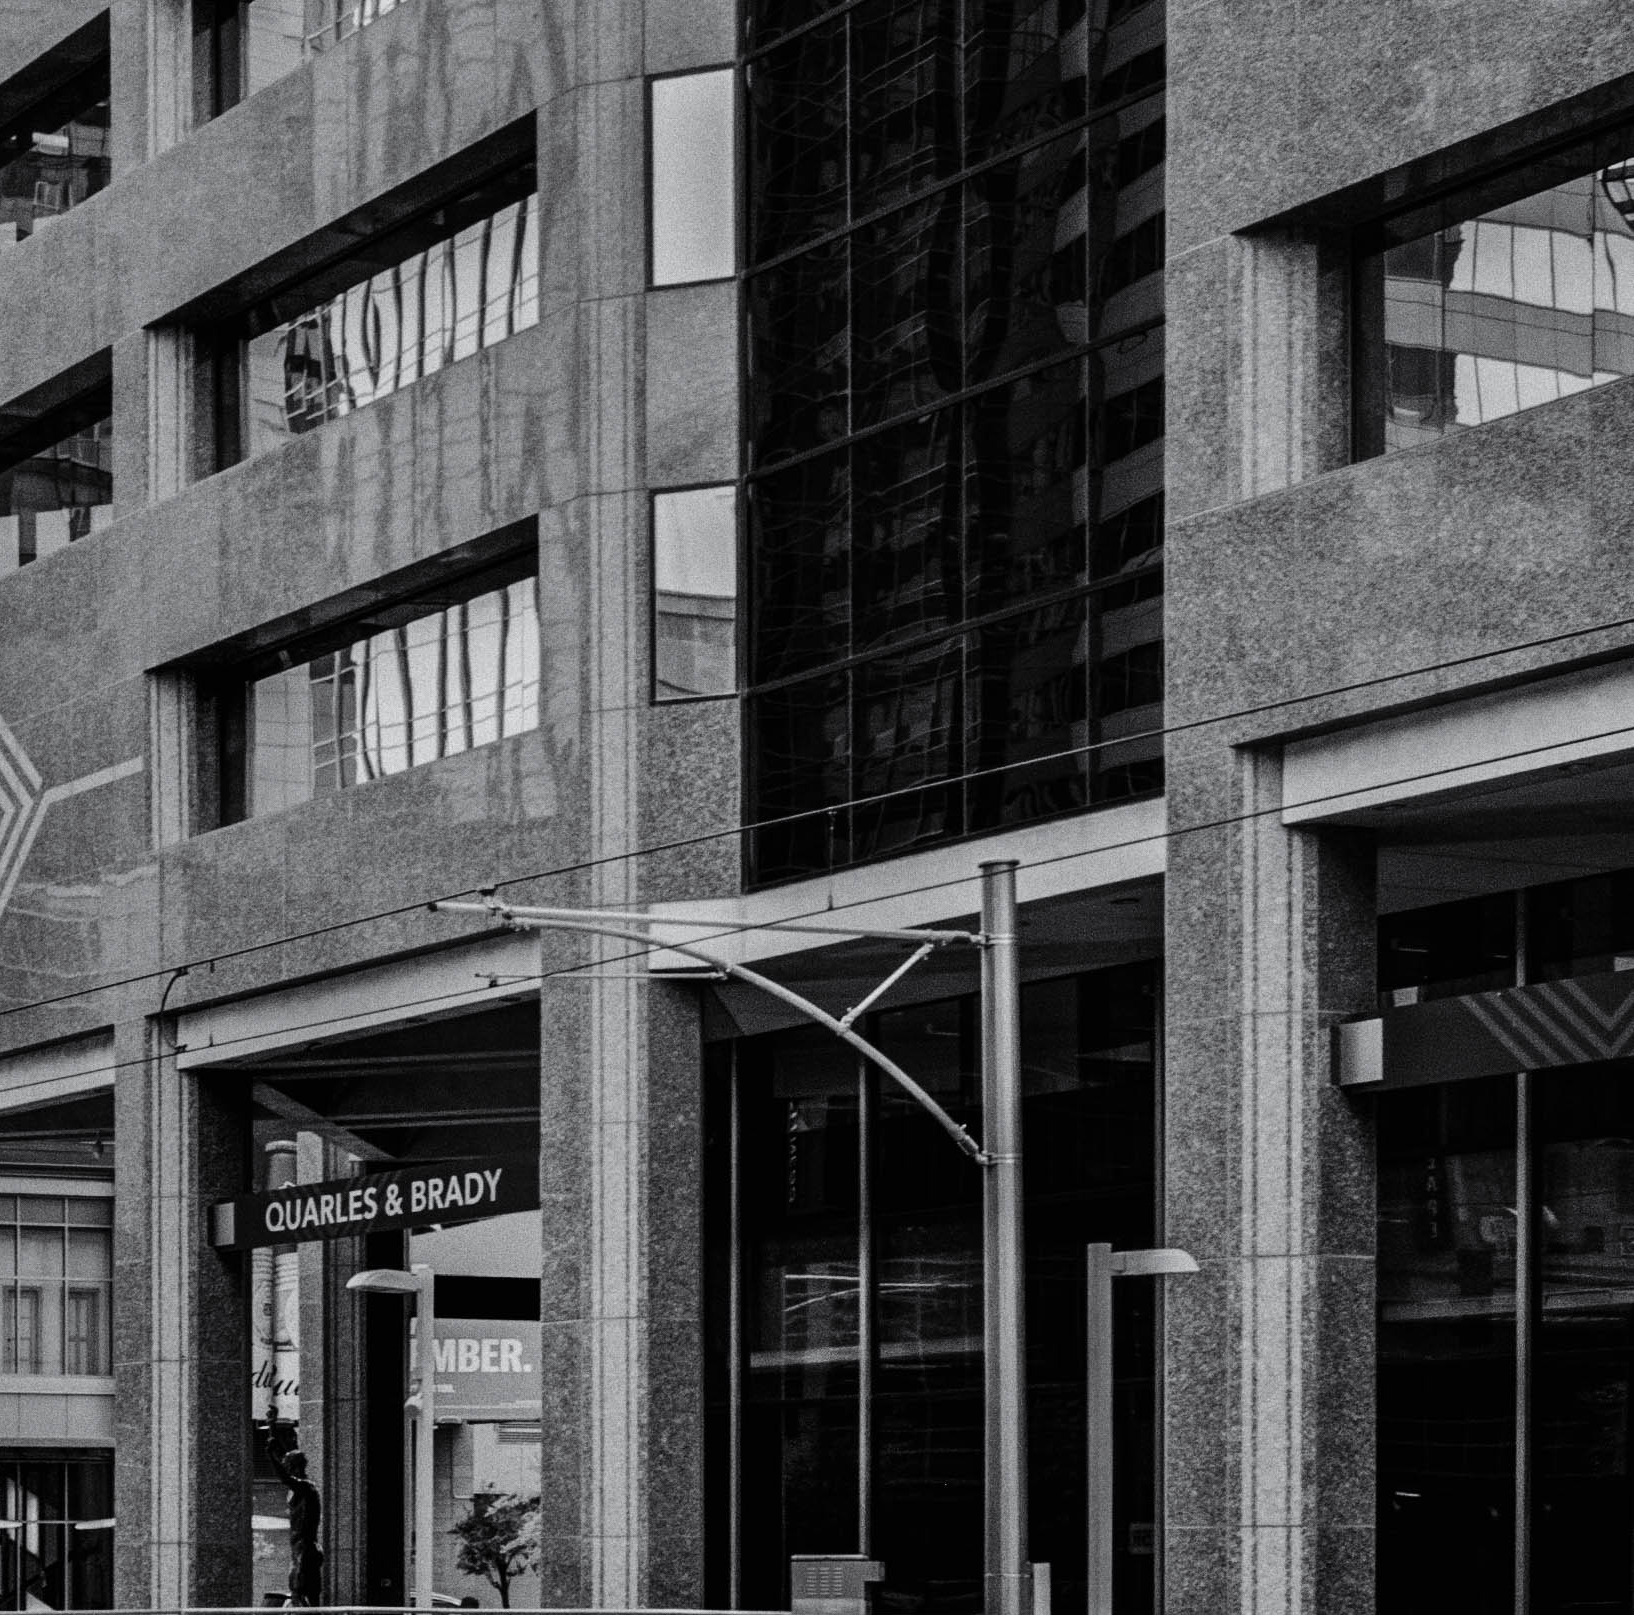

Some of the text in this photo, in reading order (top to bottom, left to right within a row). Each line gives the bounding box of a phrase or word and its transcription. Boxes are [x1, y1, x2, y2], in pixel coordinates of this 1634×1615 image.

[265, 1168, 503, 1232] QUARLES & BRADY
